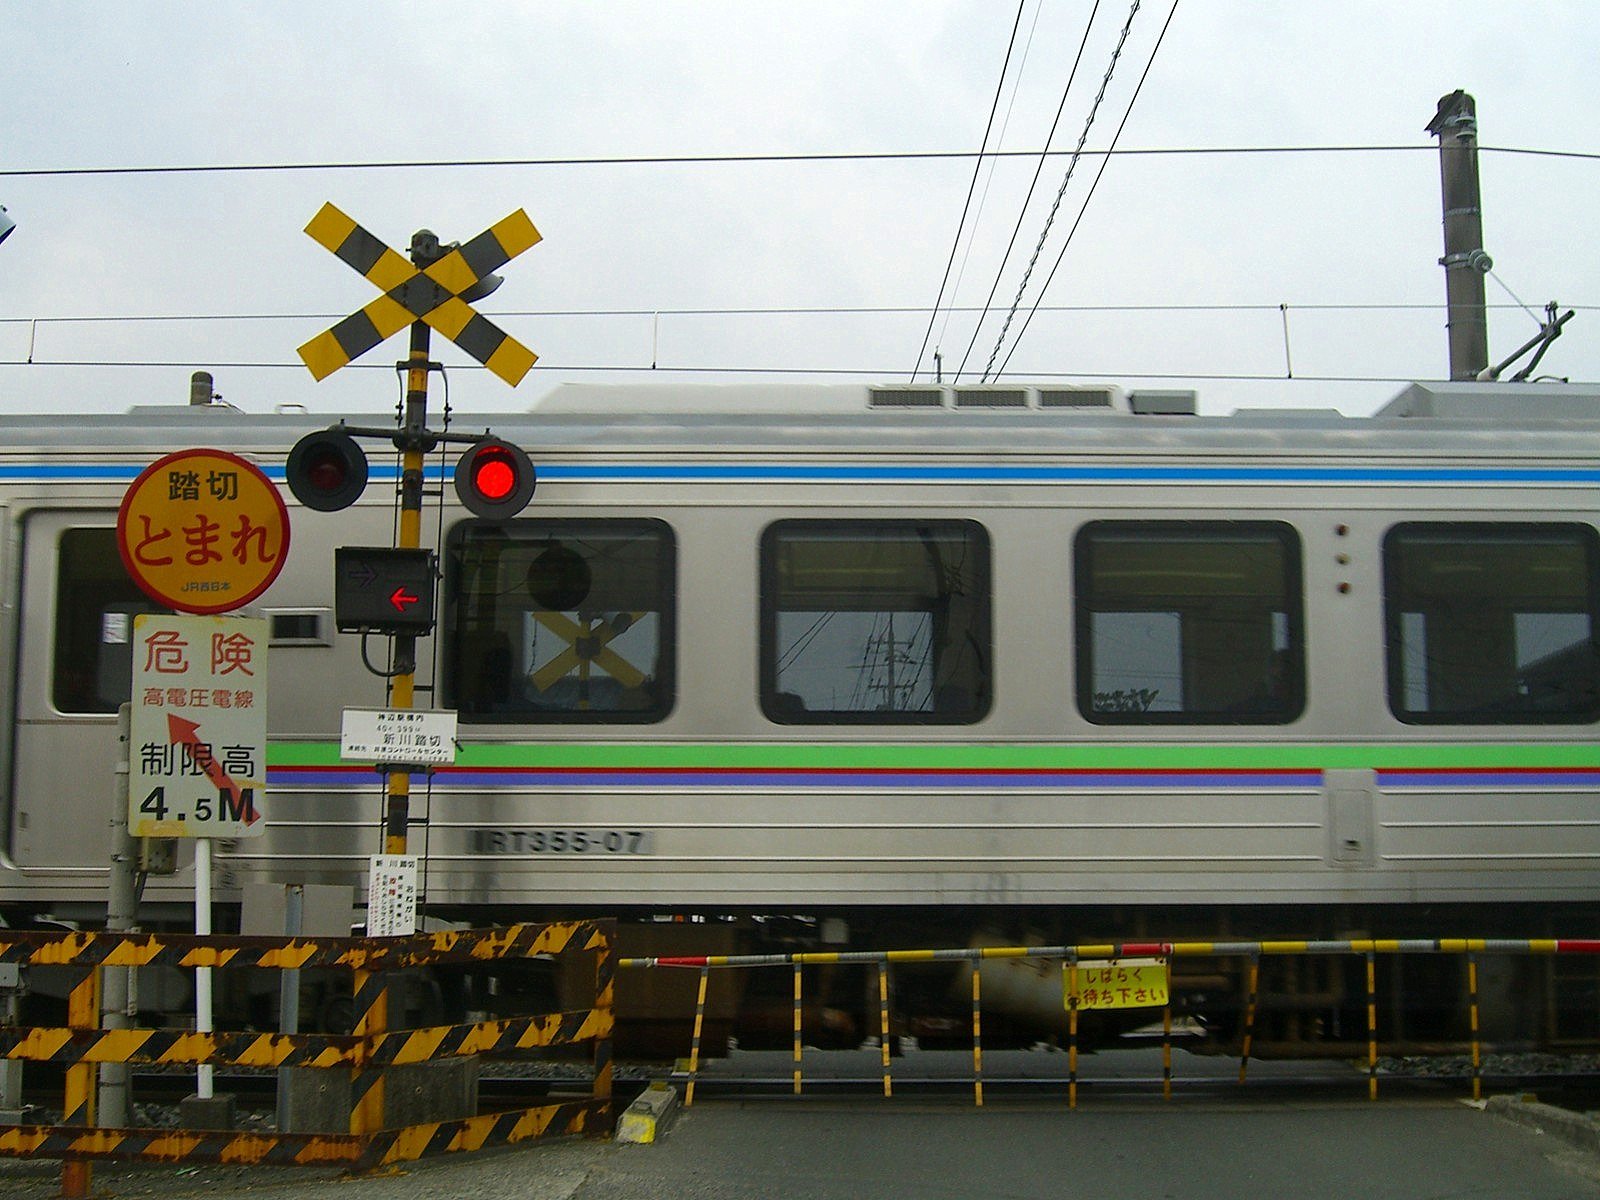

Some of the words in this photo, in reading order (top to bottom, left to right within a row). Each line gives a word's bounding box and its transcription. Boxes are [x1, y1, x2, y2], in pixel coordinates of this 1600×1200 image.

[169, 470, 238, 501] 踏切
[134, 514, 276, 566] とまれ
[181, 581, 231, 593] JR西日本
[144, 630, 255, 676] 危険
[143, 687, 254, 709] 高電圧電線
[140, 742, 256, 778] 制限高
[140, 786, 254, 822] 4.5M
[1086, 968, 1142, 984] しばらく
